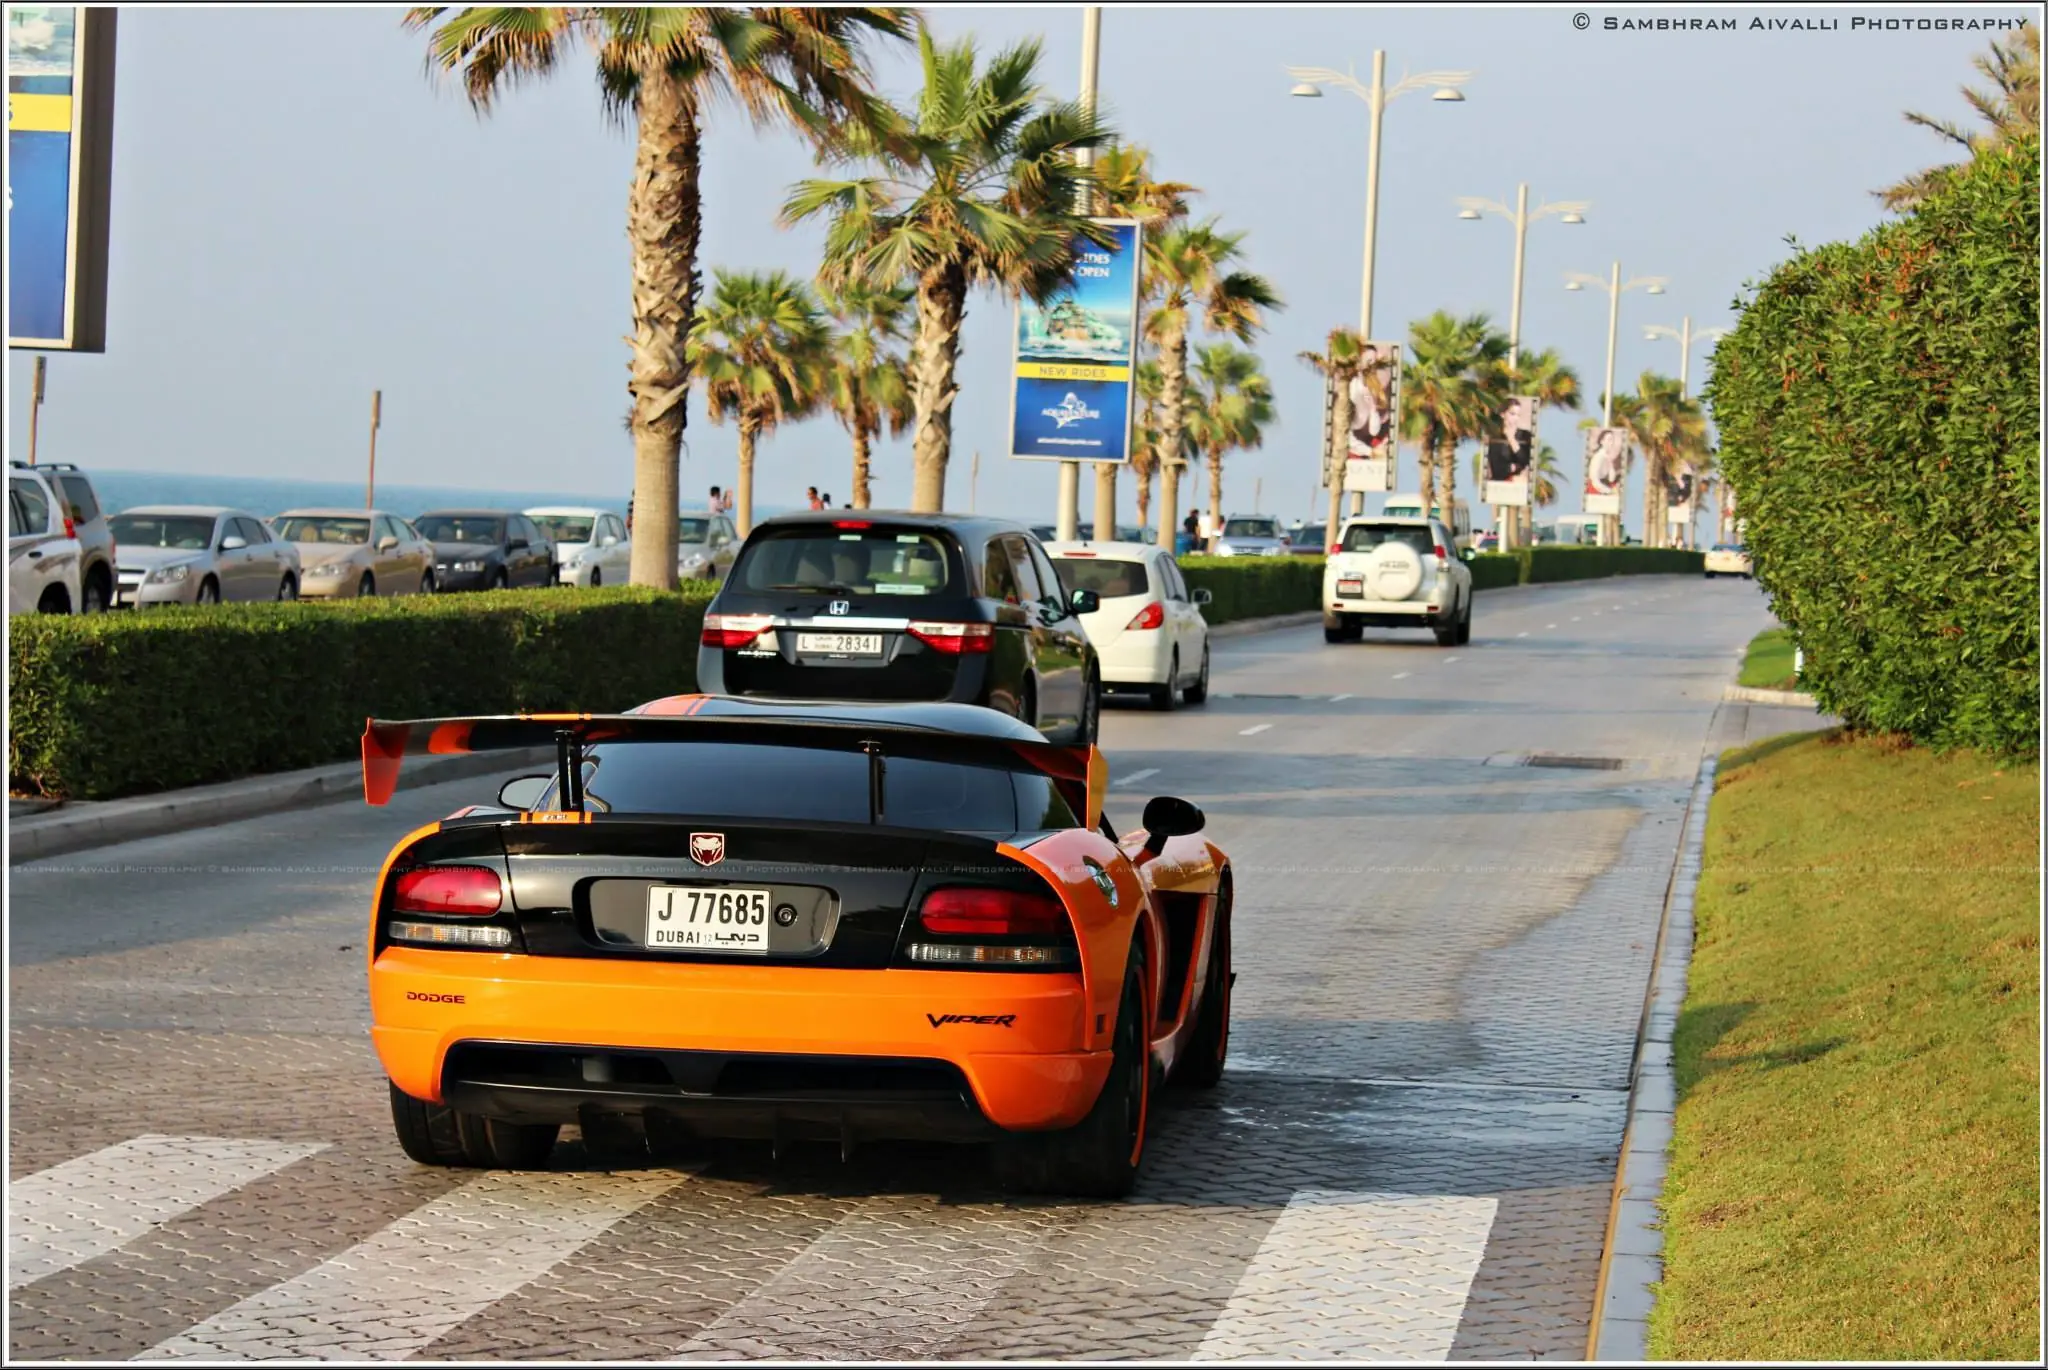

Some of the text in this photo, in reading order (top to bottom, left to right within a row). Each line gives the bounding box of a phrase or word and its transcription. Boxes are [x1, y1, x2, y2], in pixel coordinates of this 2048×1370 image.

[1077, 266, 1111, 278] OPEN
[1040, 366, 1106, 378] NEW RIDES
[801, 635, 878, 651] L 28341
[658, 892, 765, 926] J 77685
[656, 930, 700, 943] DUBAI
[406, 991, 466, 1005] DODGE
[926, 1013, 1017, 1029] VIPER
